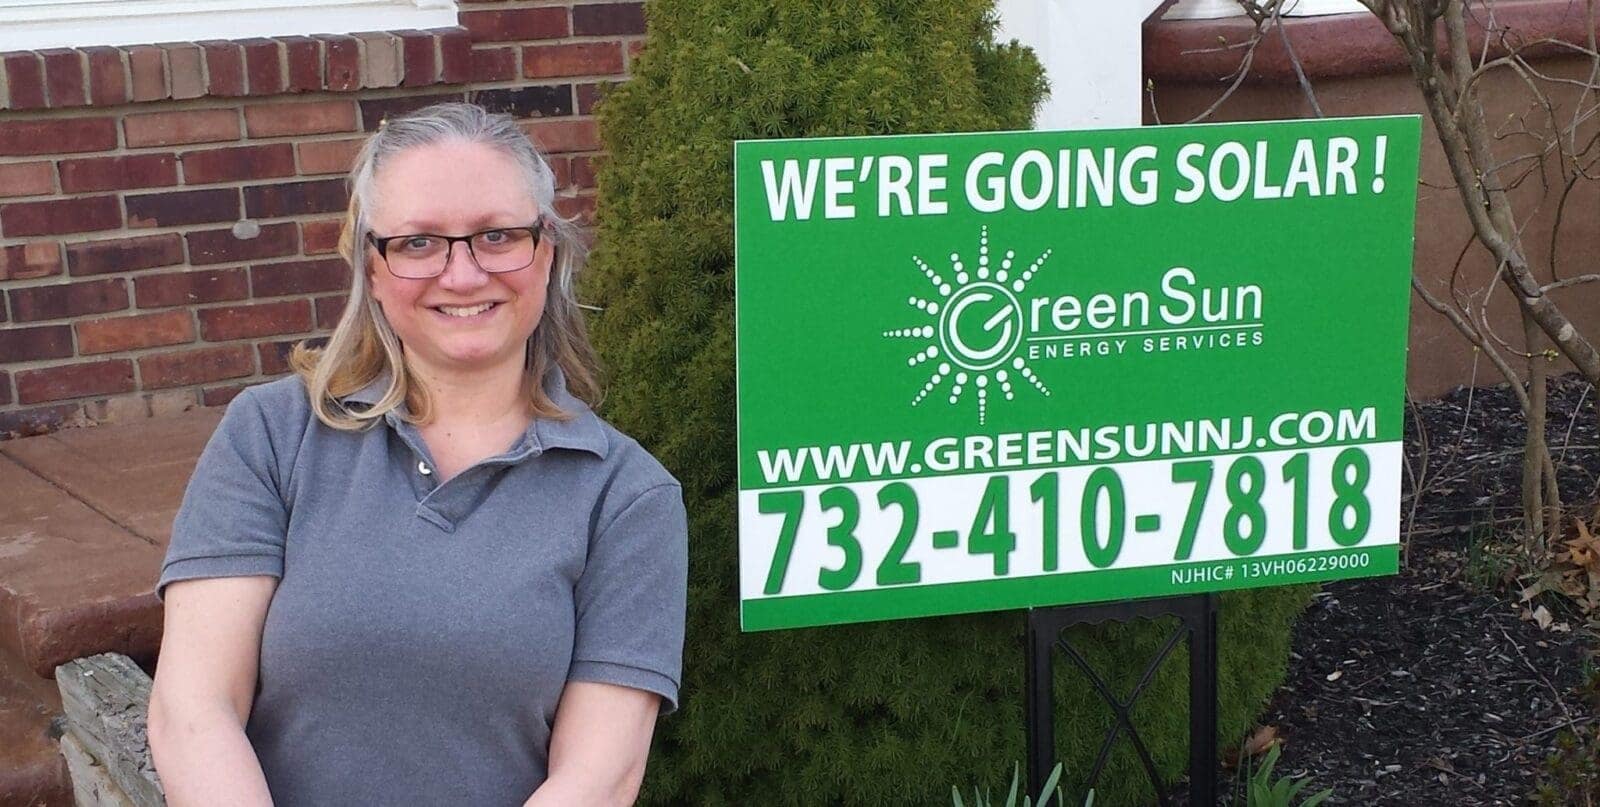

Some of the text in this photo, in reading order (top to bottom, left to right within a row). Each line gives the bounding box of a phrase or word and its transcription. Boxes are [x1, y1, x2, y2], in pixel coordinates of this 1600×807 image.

[761, 155, 948, 221] WE'RE
[965, 143, 1158, 211] GOING
[1028, 331, 1264, 360] ENERGY SERVICES
[757, 407, 1377, 484] WWW.GREENSUNNJ.COM
[757, 446, 1371, 596] 732-410-7818
[1171, 552, 1370, 585] NJHIC# 13VH06229000
